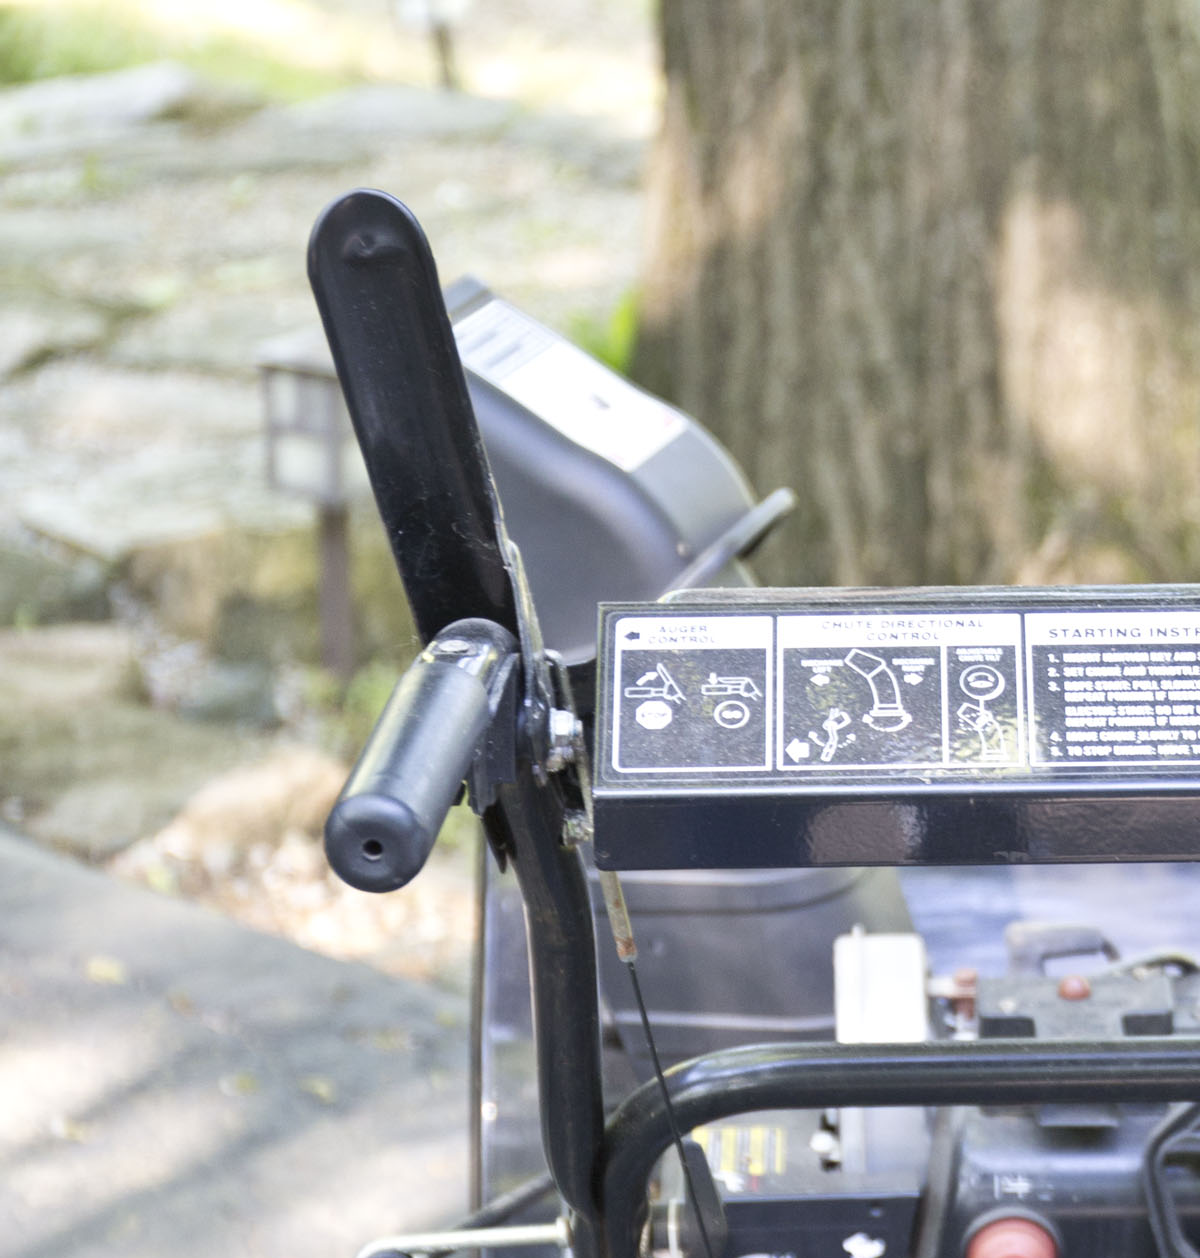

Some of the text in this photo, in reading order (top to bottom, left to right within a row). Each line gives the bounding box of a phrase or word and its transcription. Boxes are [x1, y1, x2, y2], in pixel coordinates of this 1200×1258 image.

[659, 625, 708, 633] AUGER
[821, 619, 984, 630] CHUTE DIRECTIONAL
[866, 632, 942, 641] CONTROL
[1049, 628, 1142, 639] STARTING
[648, 636, 716, 644] CONTROL
[1048, 667, 1059, 677] 2.
[1048, 681, 1060, 691] 3.
